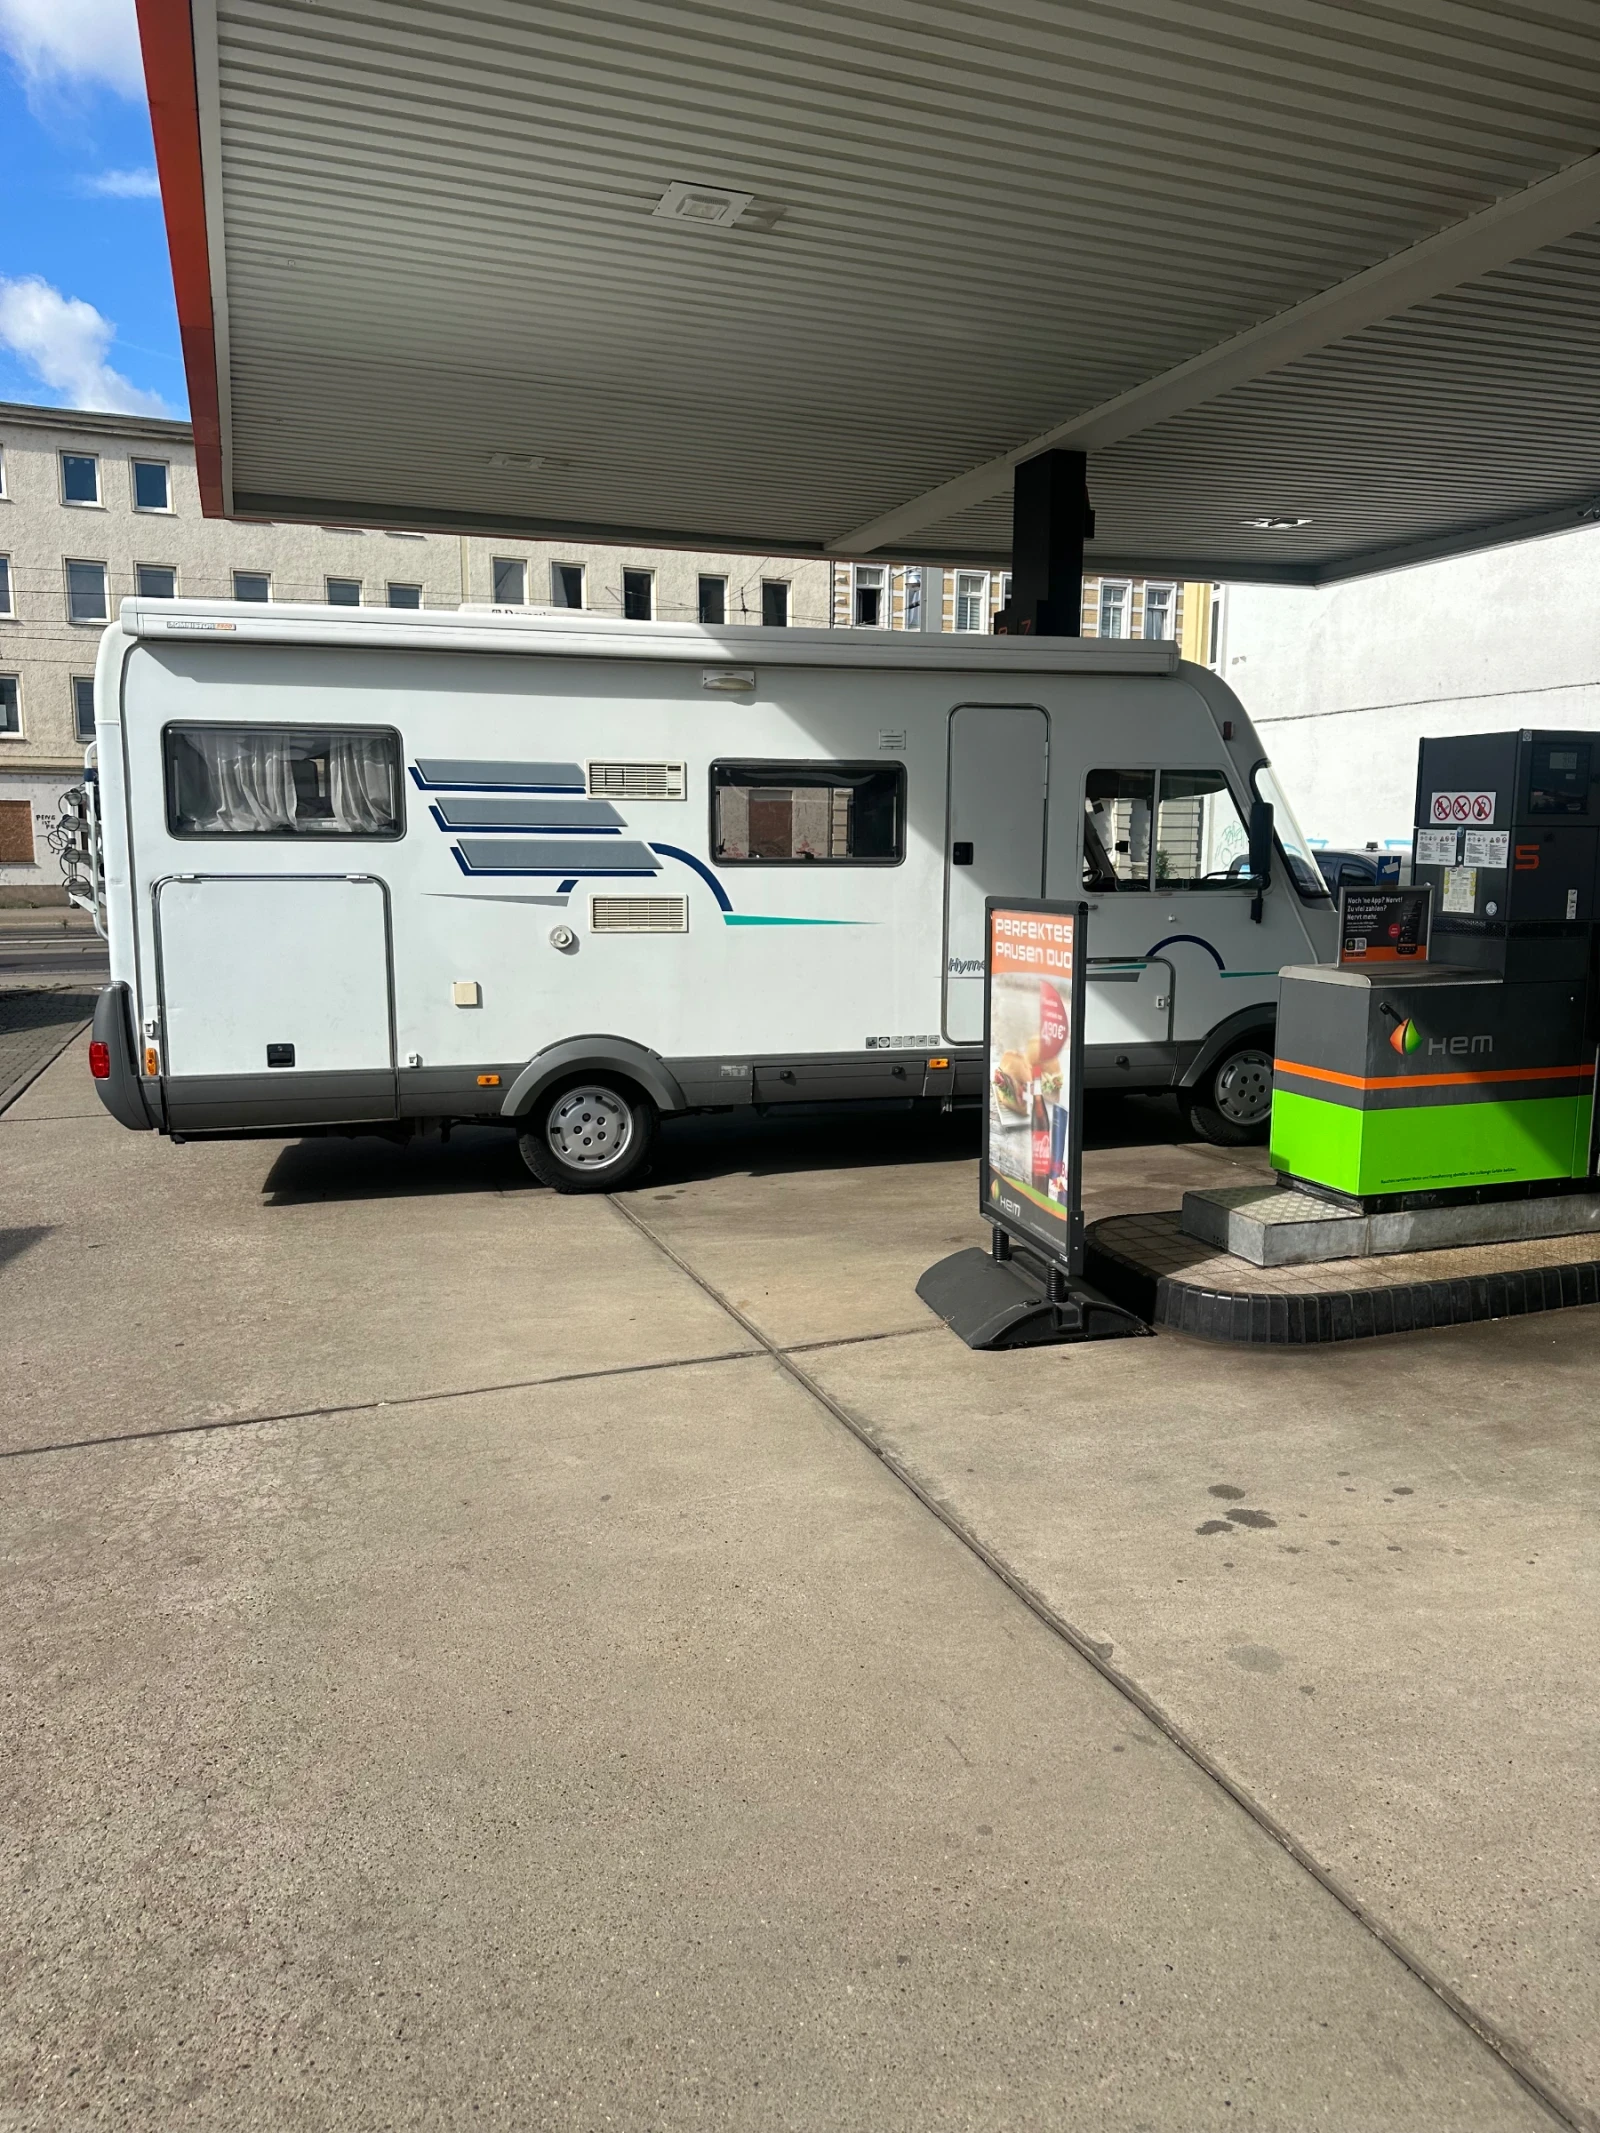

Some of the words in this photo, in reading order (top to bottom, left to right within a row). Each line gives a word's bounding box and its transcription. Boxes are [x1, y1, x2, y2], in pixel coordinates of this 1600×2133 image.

[1515, 845, 1540, 870] 5
[1371, 897, 1386, 905] App?
[1046, 949, 1073, 969] DUO
